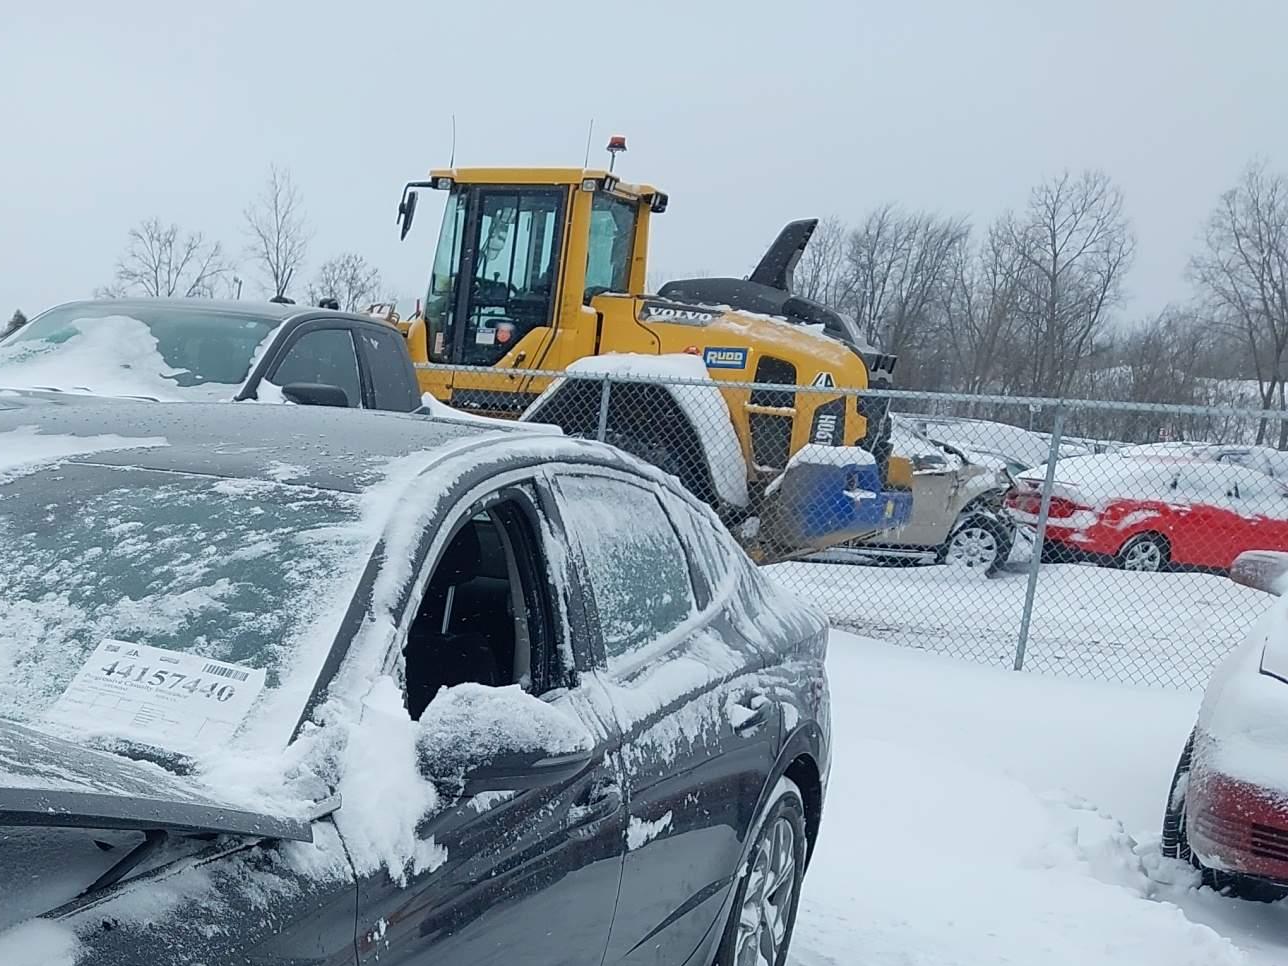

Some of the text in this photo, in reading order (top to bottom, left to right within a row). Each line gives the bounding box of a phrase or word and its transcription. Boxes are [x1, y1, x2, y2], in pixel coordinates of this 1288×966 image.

[648, 306, 712, 321] VOLVO
[706, 350, 743, 364] RUDD
[101, 660, 235, 702] 44157440
